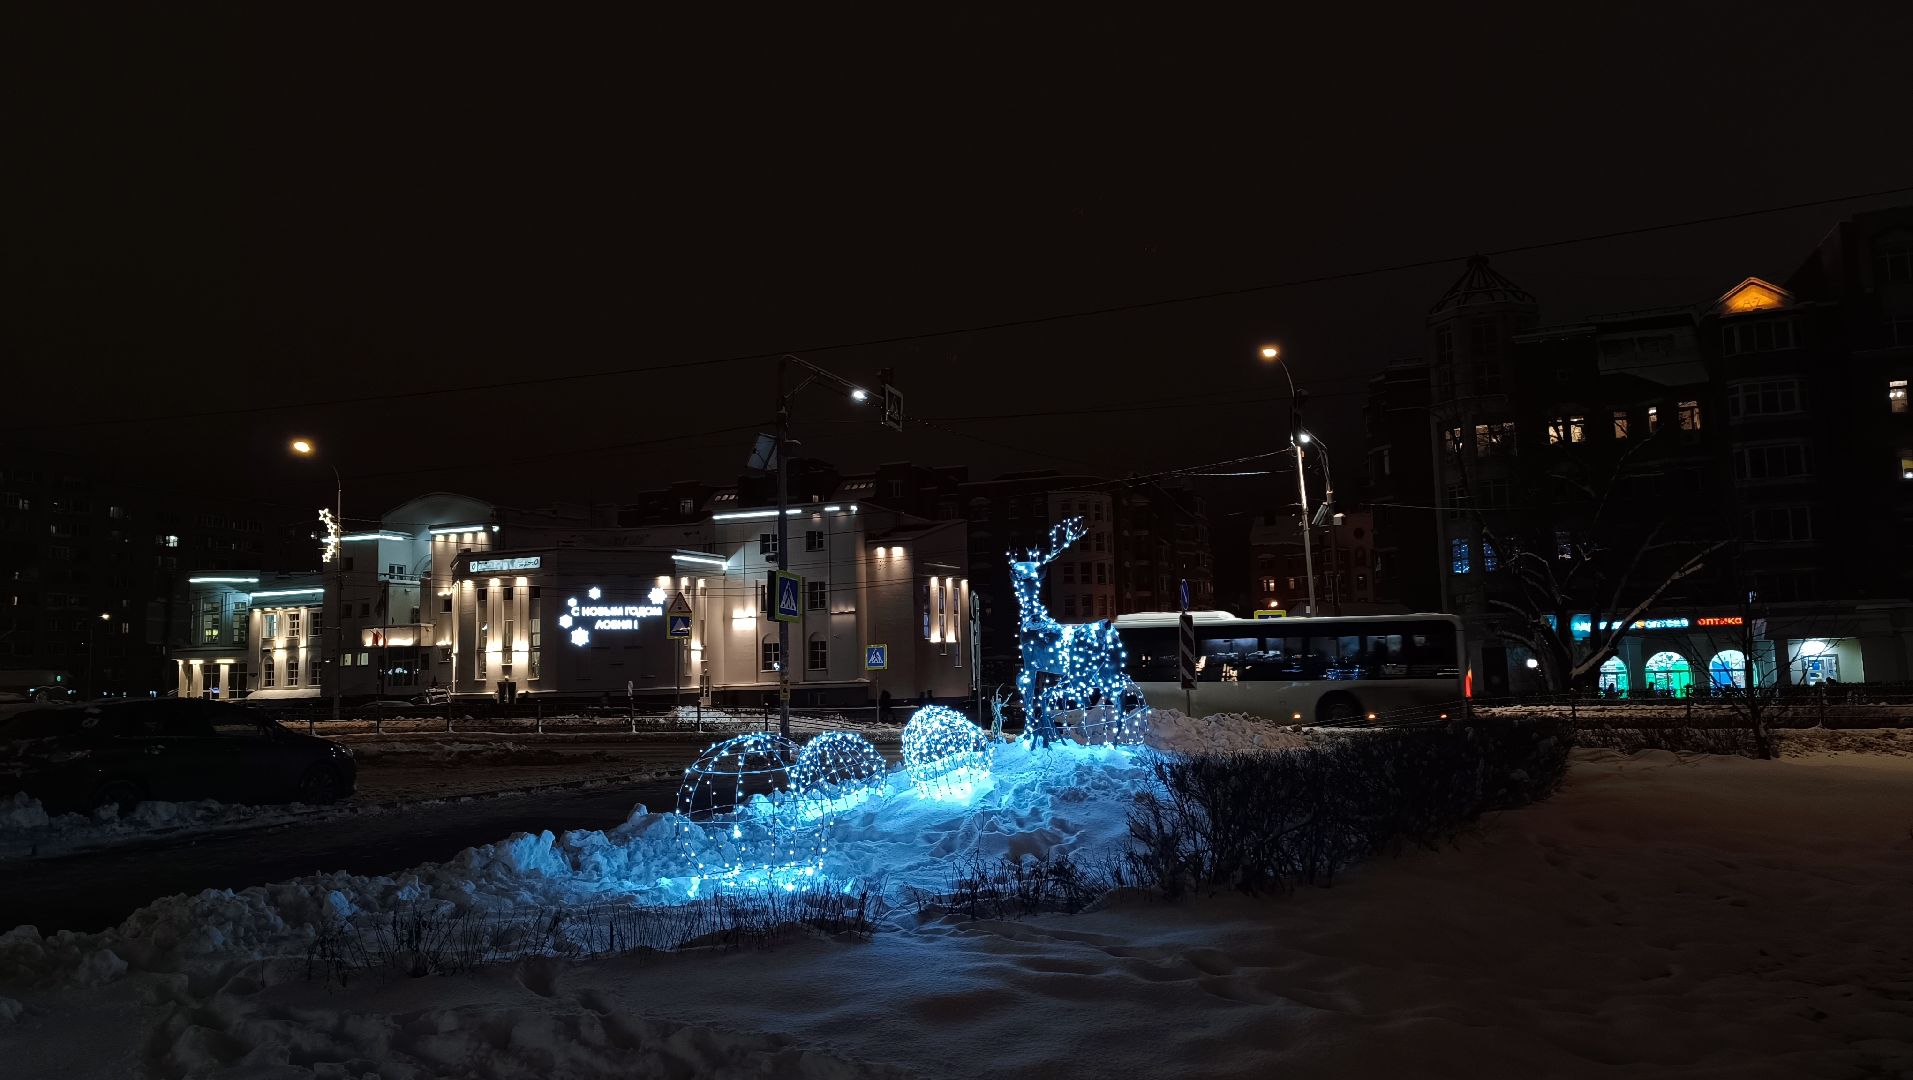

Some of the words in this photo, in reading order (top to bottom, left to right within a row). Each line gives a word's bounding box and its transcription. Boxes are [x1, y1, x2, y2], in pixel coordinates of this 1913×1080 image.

[571, 606, 580, 617] С
[581, 606, 624, 617] НОВЫМ
[624, 606, 663, 618] ГОДОМ
